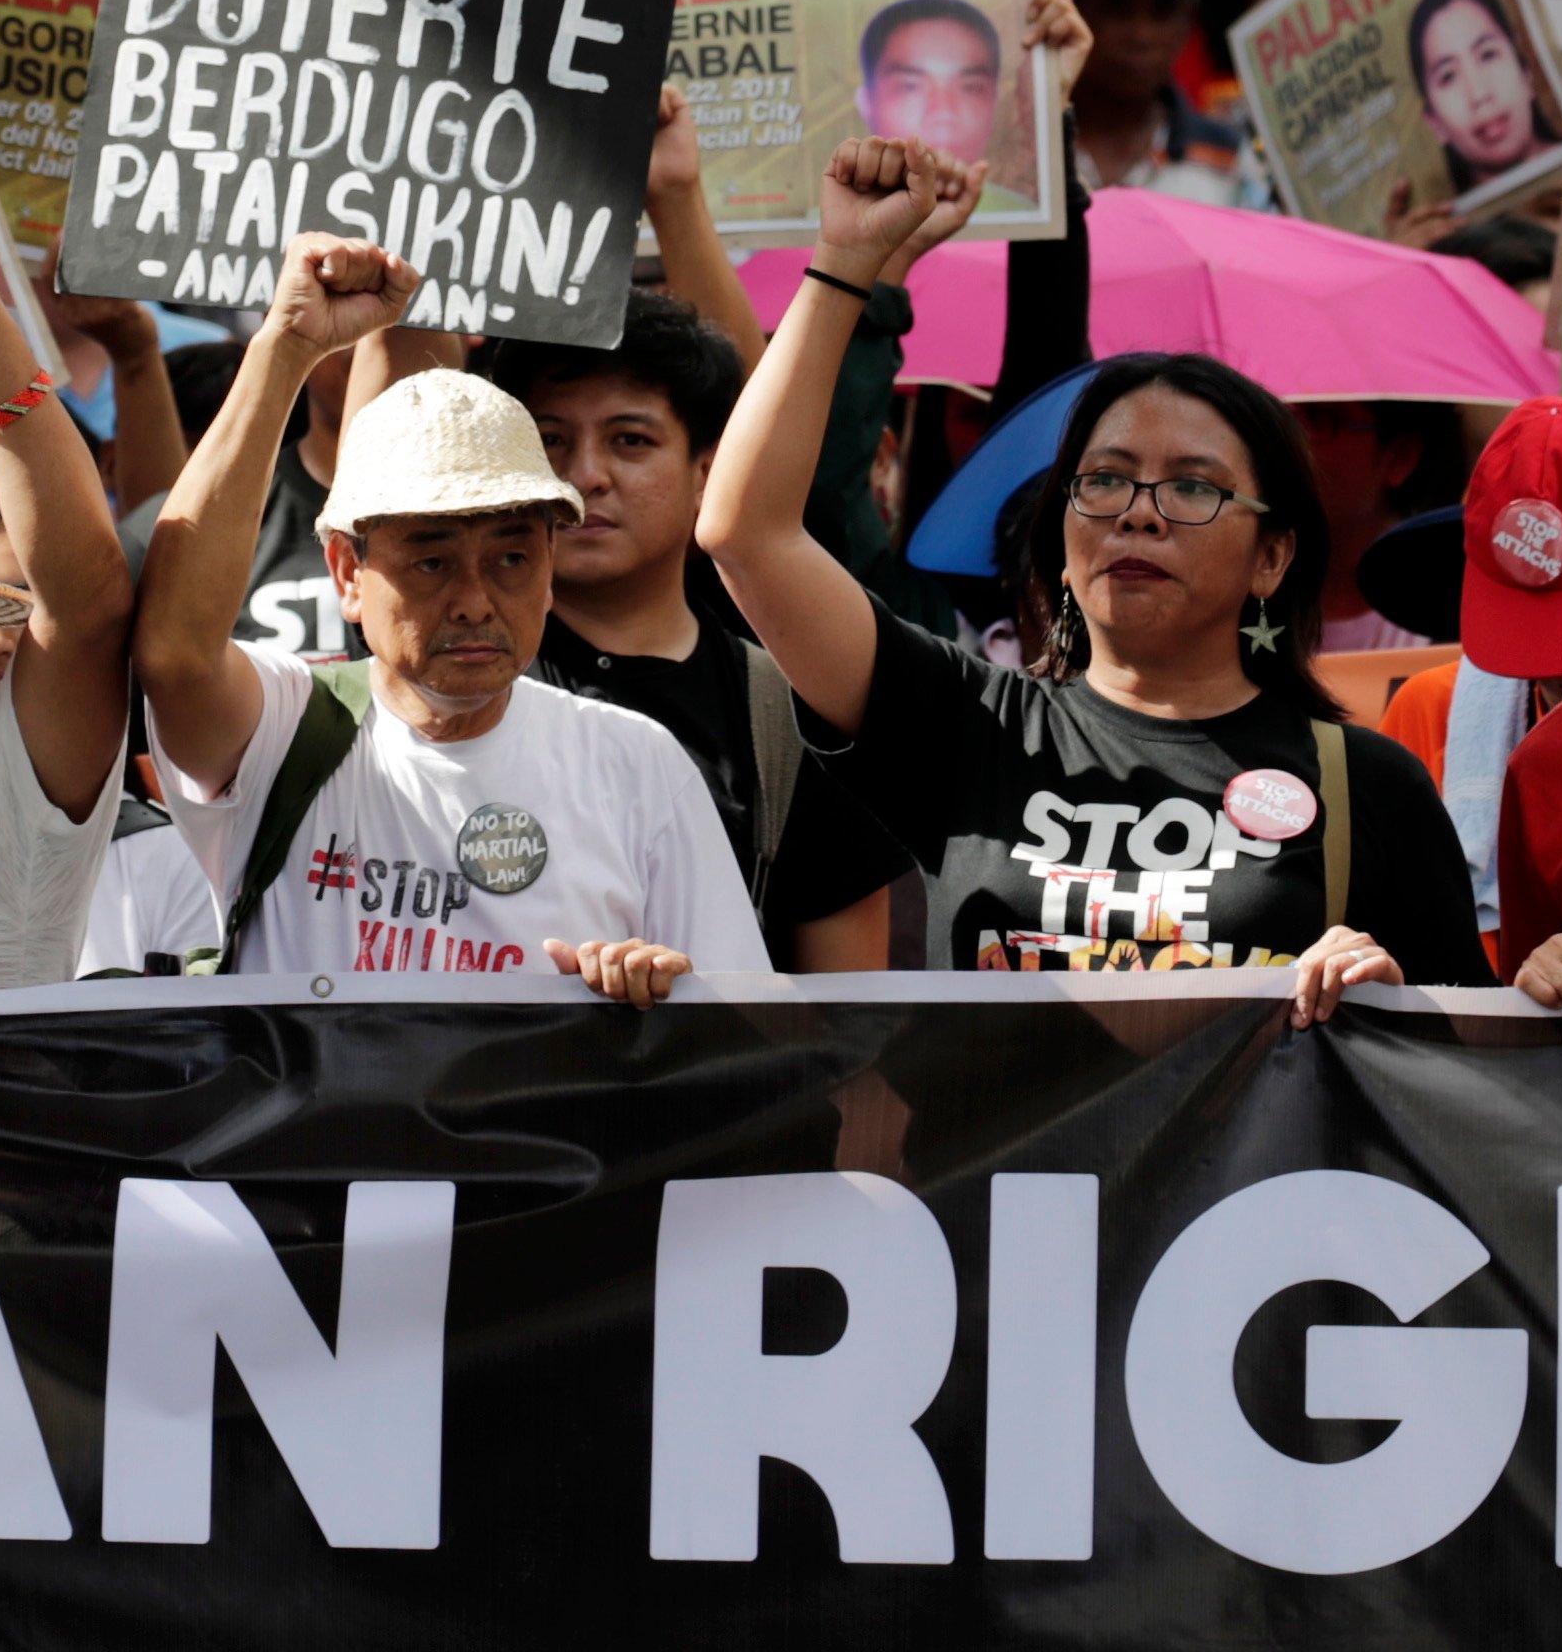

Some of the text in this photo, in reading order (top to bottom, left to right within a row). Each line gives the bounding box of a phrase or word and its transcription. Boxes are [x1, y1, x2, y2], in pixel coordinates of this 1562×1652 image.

[731, 77, 792, 100] 2011
[107, 38, 537, 193] BERDUGO
[750, 100, 803, 126] City
[1, 123, 39, 148] del
[756, 124, 804, 147] Jail
[1517, 510, 1559, 541] STOP
[1522, 528, 1548, 550] THE
[1492, 531, 1562, 578] ATTACKS
[1255, 777, 1302, 800] STOP
[1262, 792, 1286, 809] THE
[469, 811, 530, 832] NO TO
[1227, 791, 1307, 830] ATTACKS
[1010, 790, 1282, 872] STOP
[459, 836, 547, 862] MARTIAL
[307, 832, 473, 926] #STOP
[486, 867, 527, 886] LAW!
[1028, 860, 1216, 942] THE
